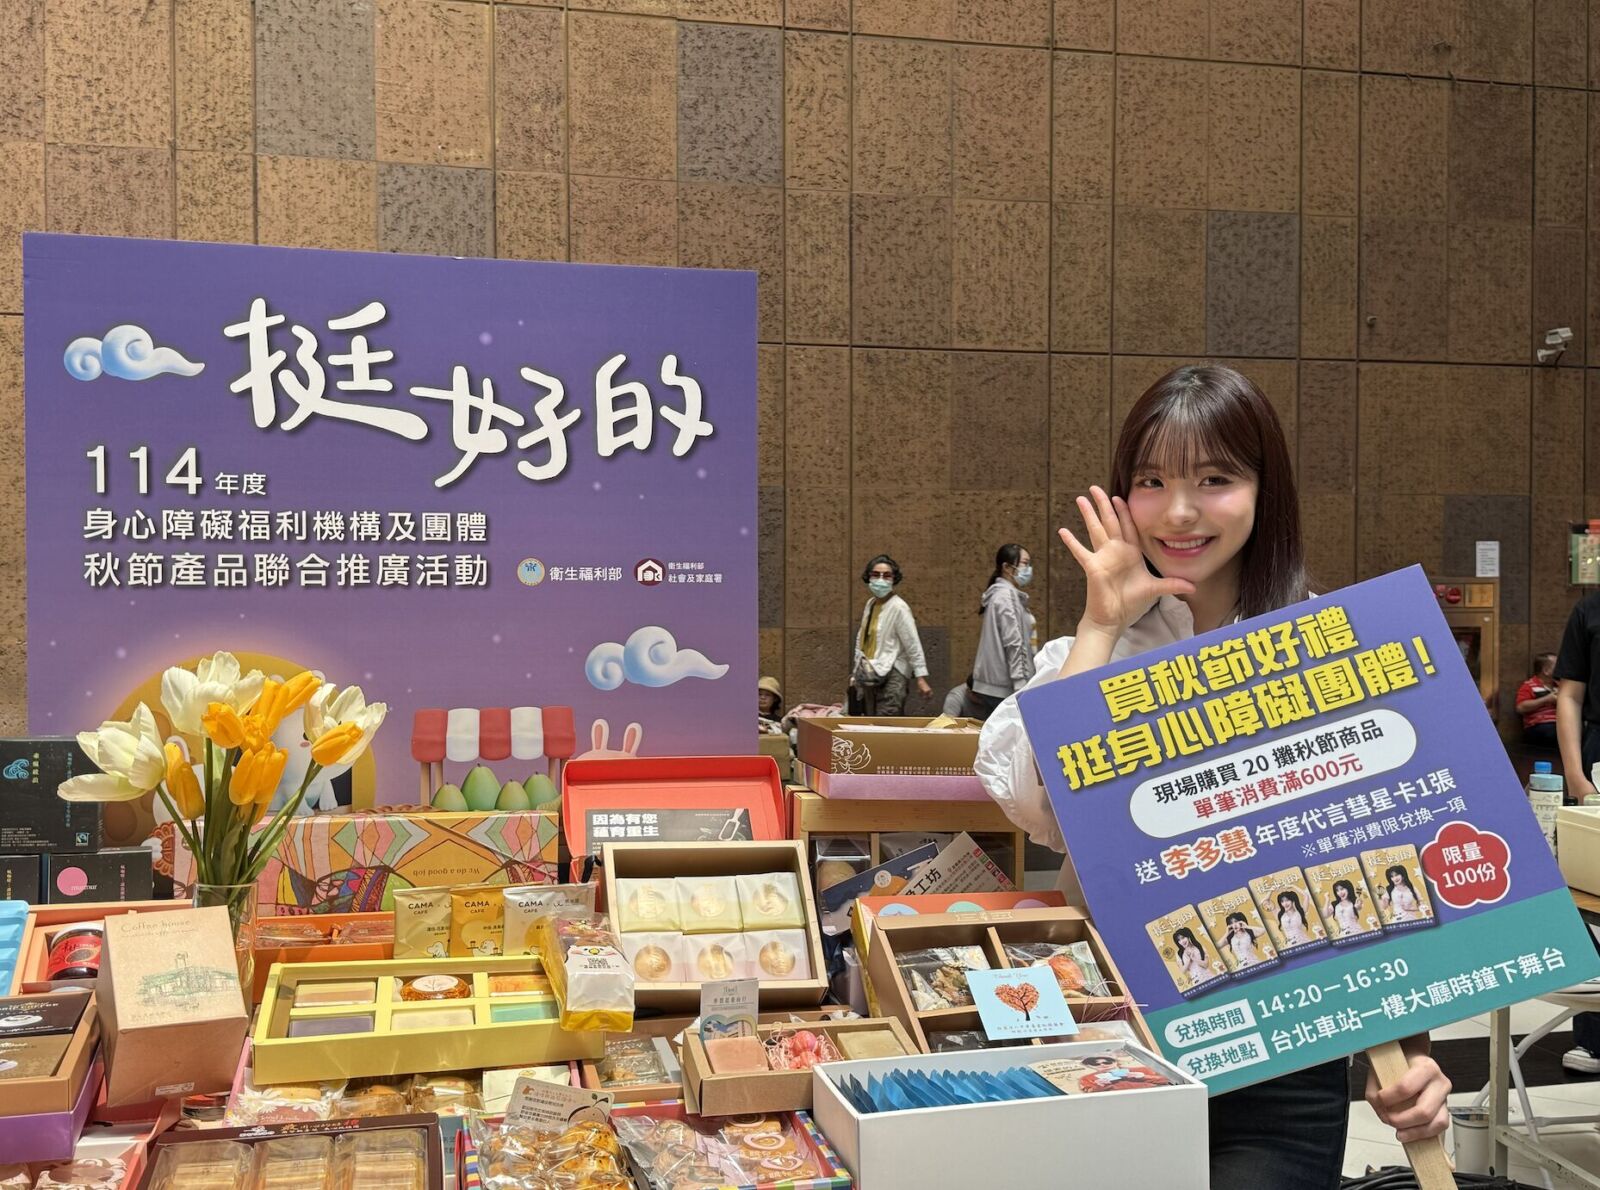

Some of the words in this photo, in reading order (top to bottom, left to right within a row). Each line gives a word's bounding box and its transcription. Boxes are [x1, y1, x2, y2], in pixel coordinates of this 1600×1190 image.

[224, 298, 713, 487] 挺好的
[86, 446, 203, 494] 114
[215, 472, 267, 495] 年度
[82, 508, 488, 543] 身心障礙福利機構及團體
[82, 552, 488, 588] 秋節產品聯合推廣活動
[549, 566, 623, 582] 衛生福利部
[668, 573, 723, 583] 社會及家庭署
[1099, 606, 1359, 722] 買秋節好禮
[1057, 636, 1436, 790] 挺身心障礙團體！
[1152, 762, 1241, 804] 現場購買
[1242, 755, 1270, 777] 20
[1272, 719, 1384, 769] 攤秋節商品
[1193, 753, 1364, 819] 單筆消費滿600元
[592, 813, 658, 826] 因為有您
[1135, 859, 1162, 885] 送
[1161, 826, 1257, 880] 李多慧
[1255, 768, 1457, 846] 年度代言彗星卡1張
[428, 868, 448, 876] good
[1441, 842, 1484, 866] 限量
[1442, 862, 1496, 888] 100份
[408, 902, 434, 910] CAMA
[1174, 1007, 1246, 1043] 兌換時間
[1187, 1041, 1260, 1077] 兌換地點
[1271, 947, 1566, 1054] 台北車站一樓大廳時鐘下舞台
